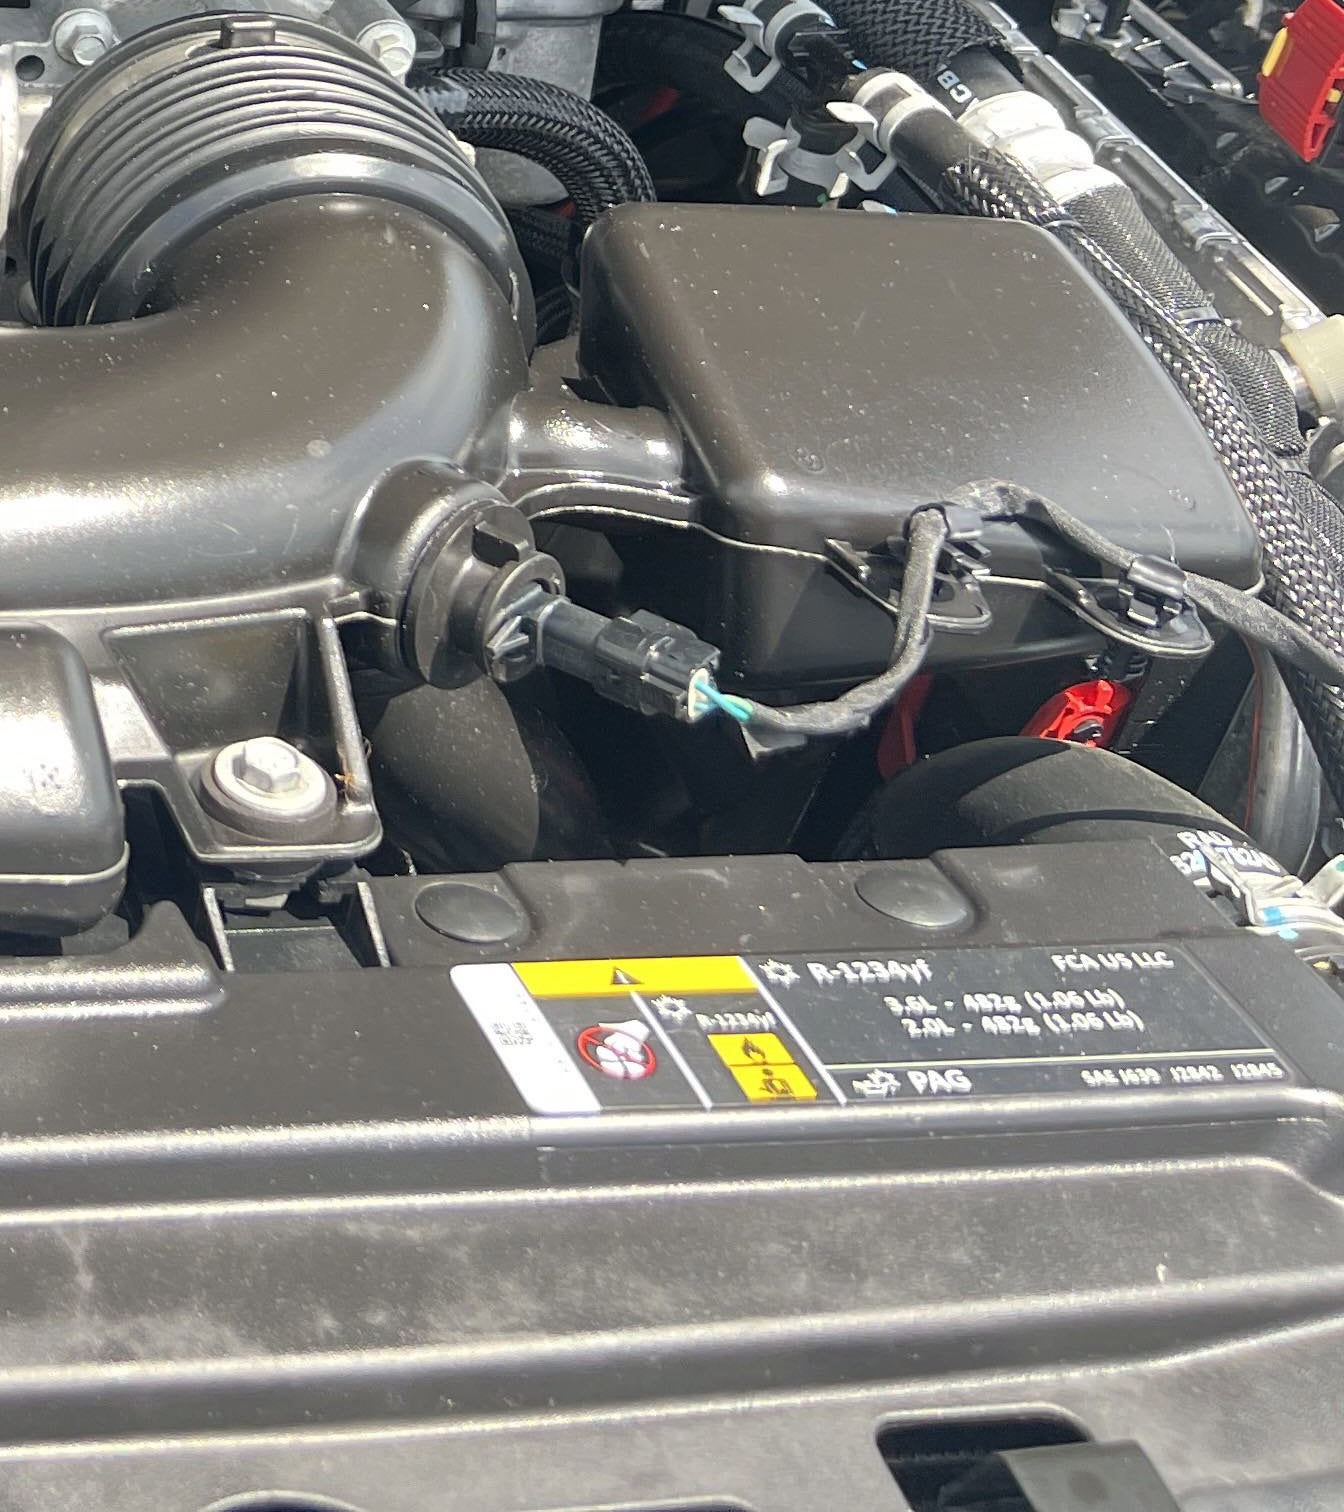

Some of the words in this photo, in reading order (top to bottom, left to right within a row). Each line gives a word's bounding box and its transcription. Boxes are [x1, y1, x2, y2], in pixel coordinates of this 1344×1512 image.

[806, 958, 933, 987] R-1234yf
[1051, 953, 1100, 972] FCA
[1096, 952, 1133, 971] US
[1131, 951, 1174, 970] LLC
[883, 995, 937, 1017] 3.6L
[1024, 990, 1086, 1013] (1.06
[1084, 988, 1126, 1010] Lb)
[901, 1018, 956, 1038] 2.0L
[1043, 1012, 1104, 1034] (1.06
[1103, 1010, 1144, 1032] Lb)
[907, 1068, 973, 1094] PAG
[1080, 1068, 1120, 1088] SAE
